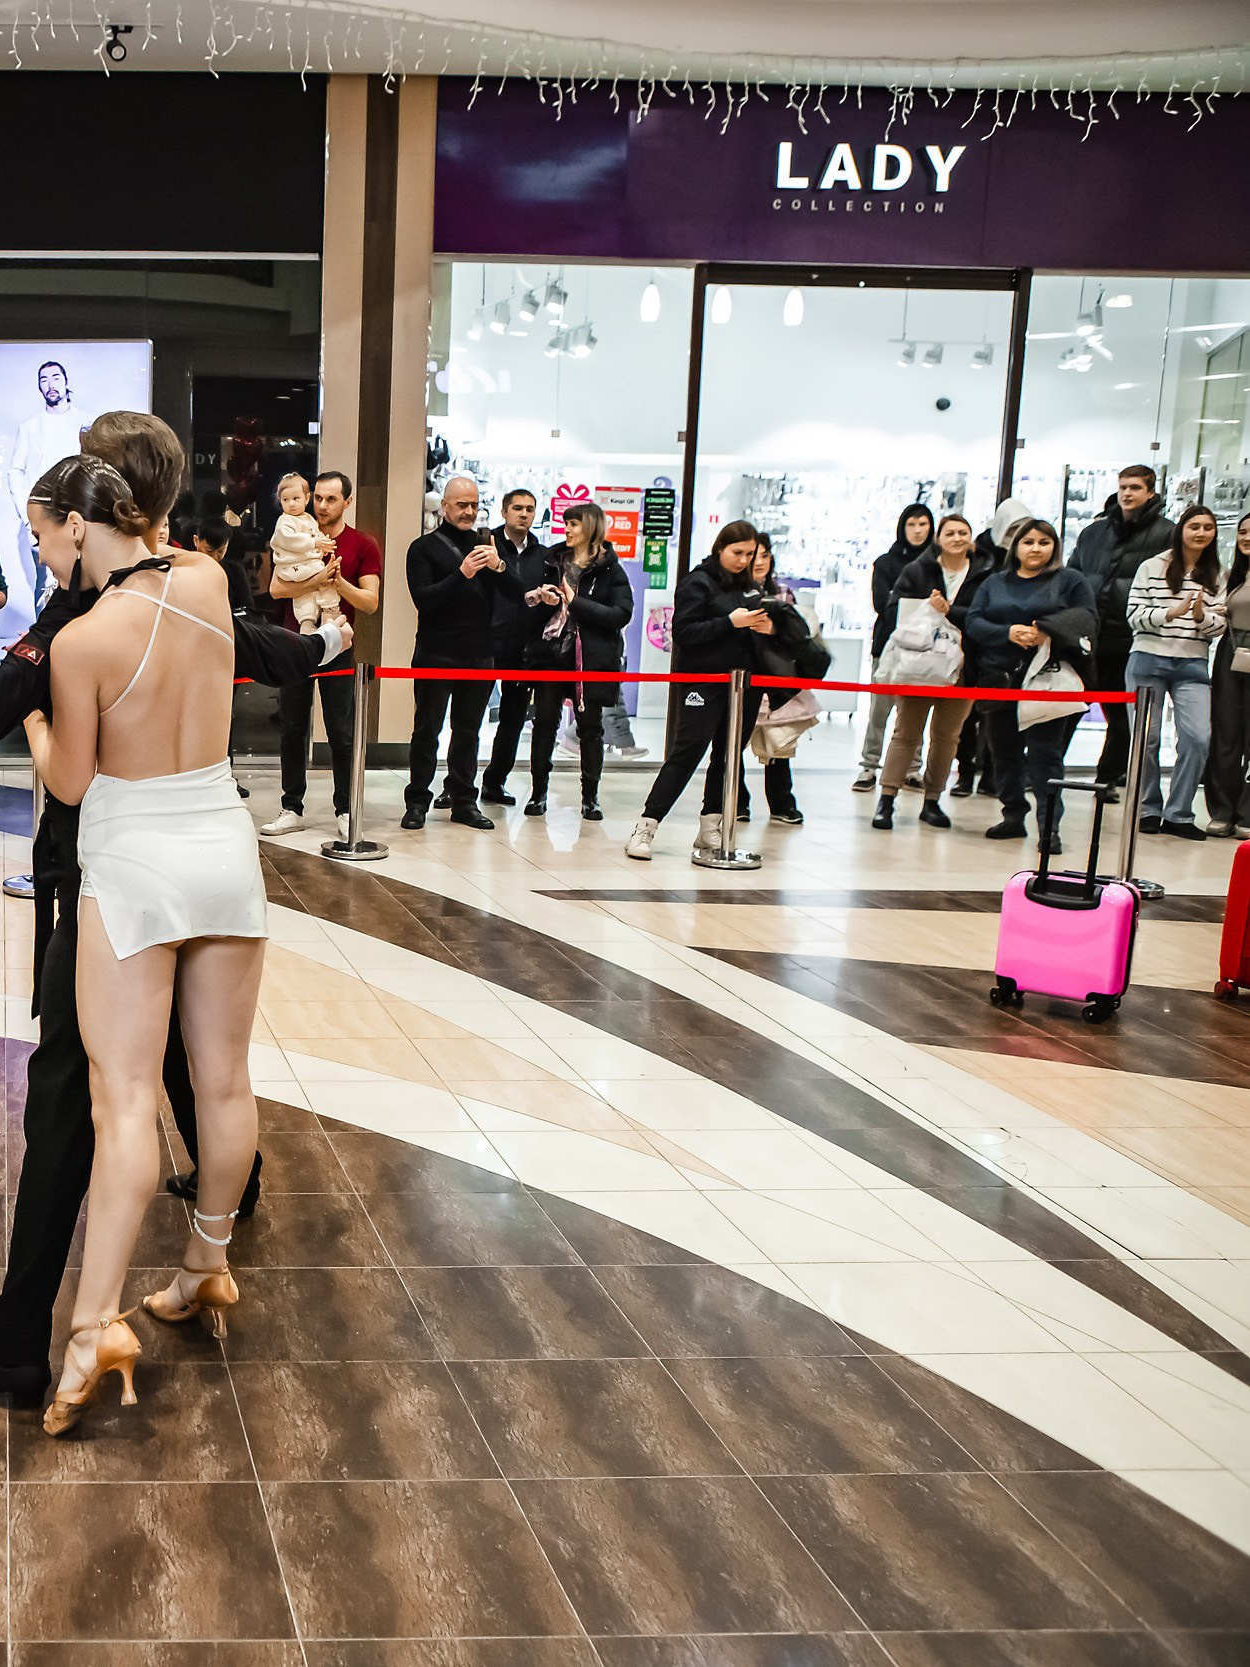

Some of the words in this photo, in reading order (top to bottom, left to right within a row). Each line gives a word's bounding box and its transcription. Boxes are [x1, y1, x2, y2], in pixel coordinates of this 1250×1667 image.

[776, 141, 967, 193] LADY
[772, 199, 944, 213] COLLECTION
[614, 521, 632, 530] RED
